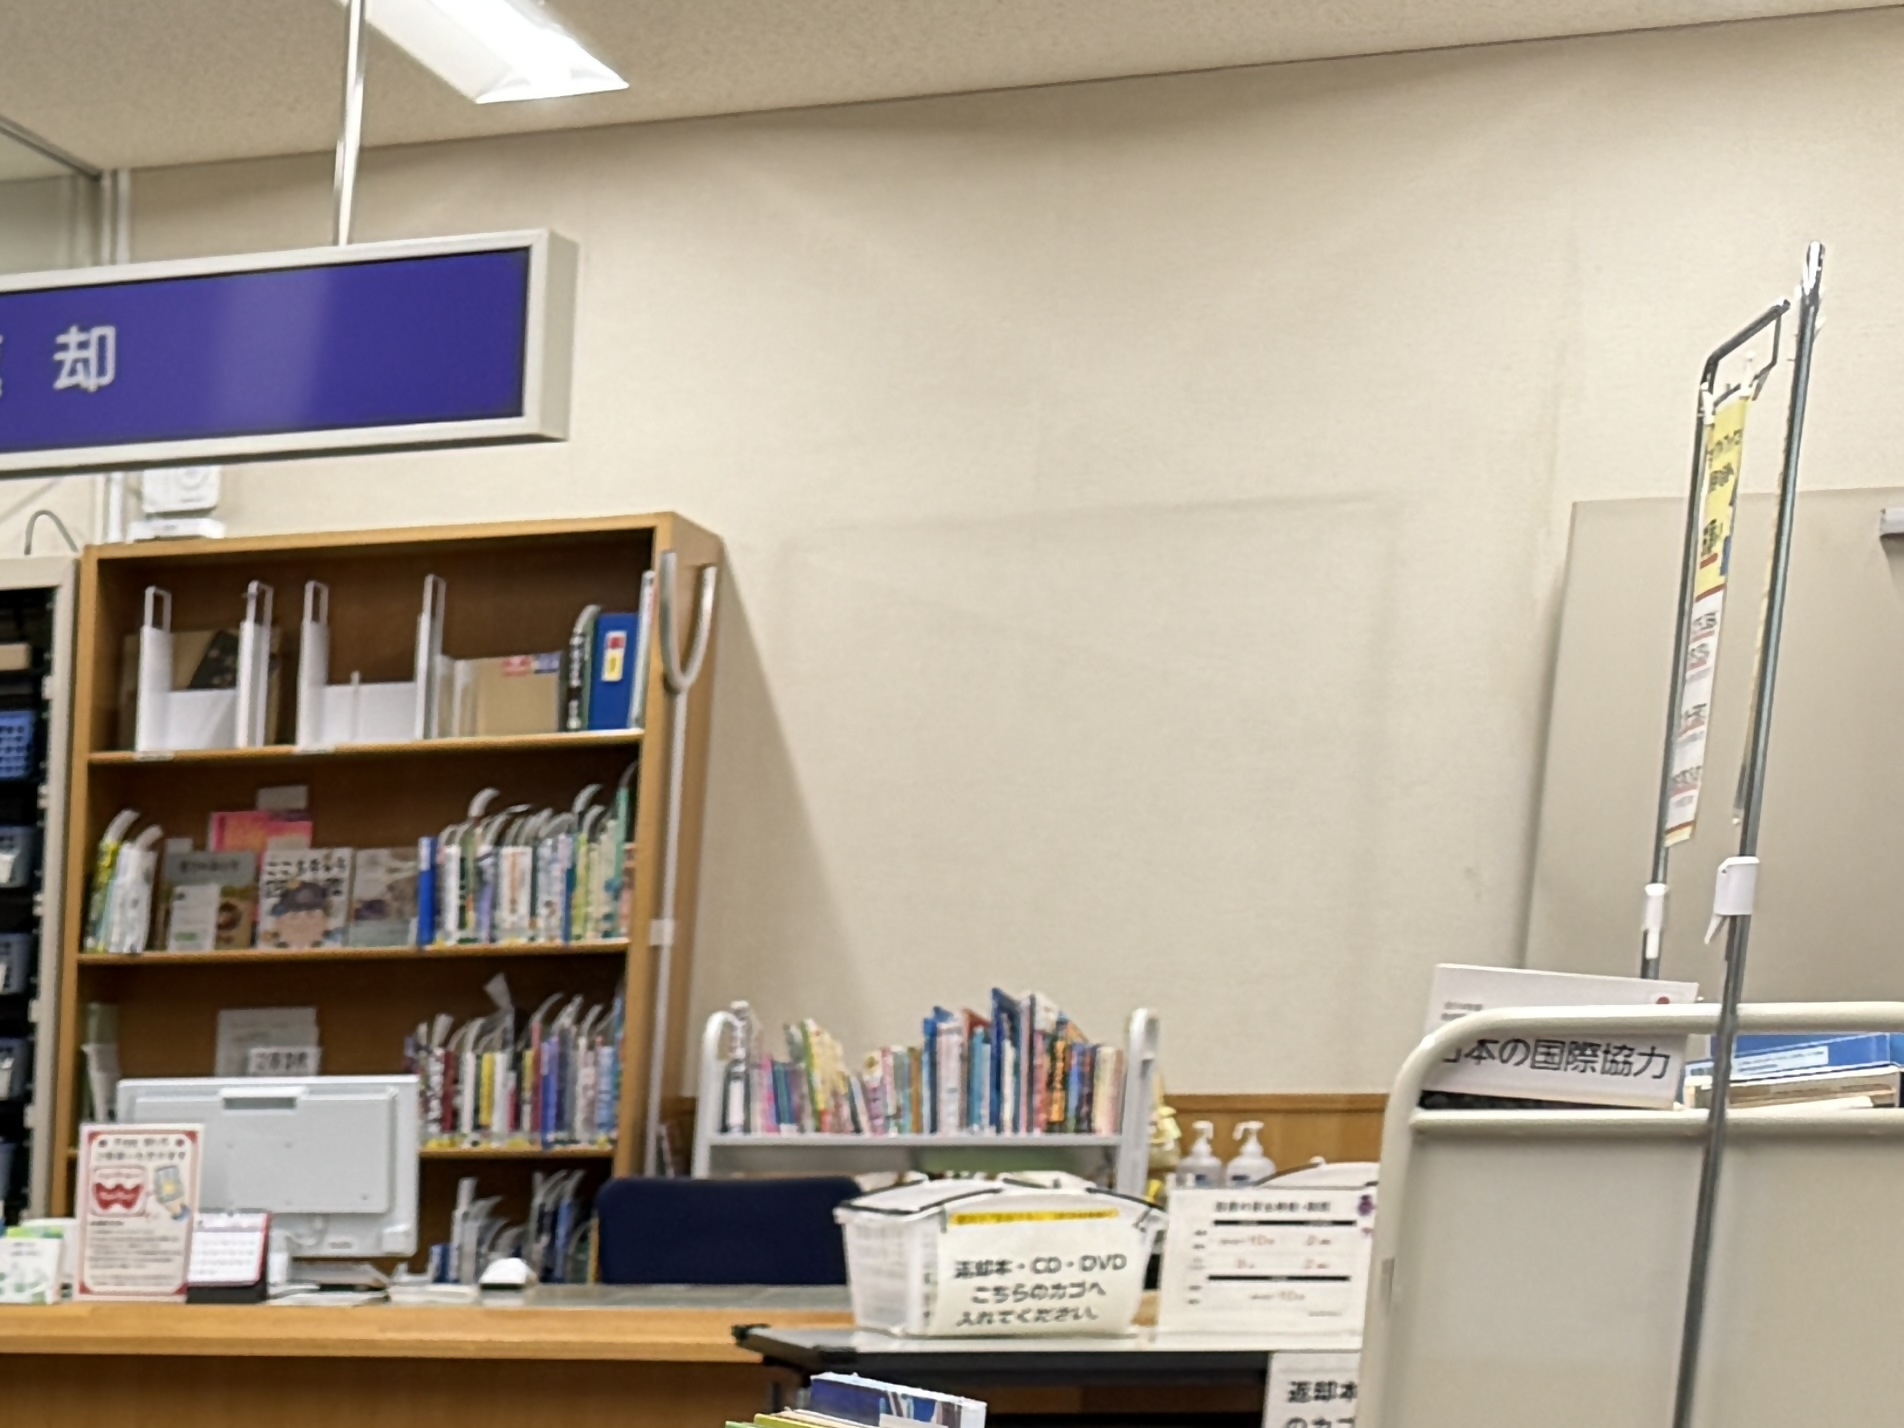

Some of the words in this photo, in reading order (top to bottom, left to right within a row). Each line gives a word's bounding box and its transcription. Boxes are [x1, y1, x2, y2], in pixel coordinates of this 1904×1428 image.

[1444, 1036, 1670, 1080] 本の国際協力
